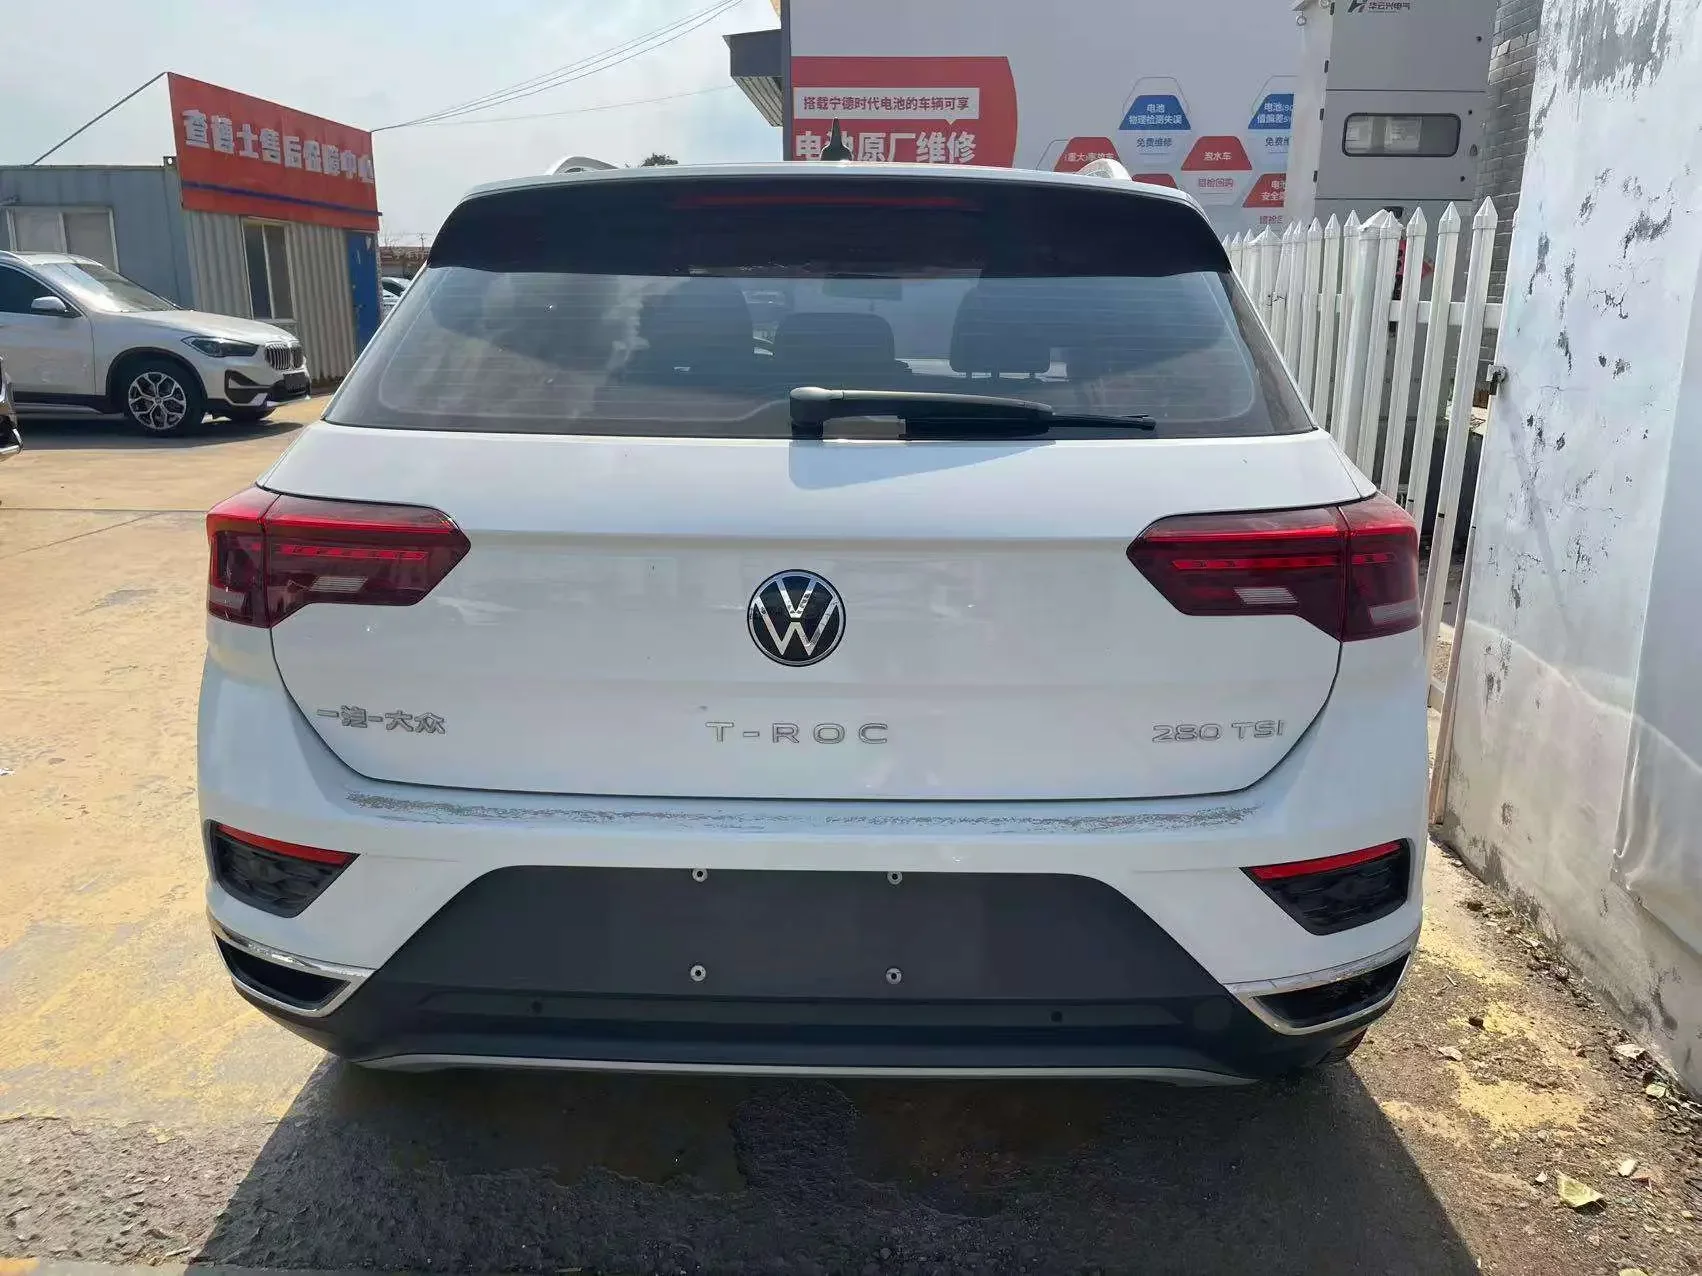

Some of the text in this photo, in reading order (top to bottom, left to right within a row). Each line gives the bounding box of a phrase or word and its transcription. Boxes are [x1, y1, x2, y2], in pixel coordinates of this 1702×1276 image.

[803, 96, 970, 111] 搭载宁德时代电池的车辆可享
[1146, 103, 1166, 113] 电池
[705, 721, 889, 745] T-ROC
[1151, 719, 1285, 743] 280 TSI
